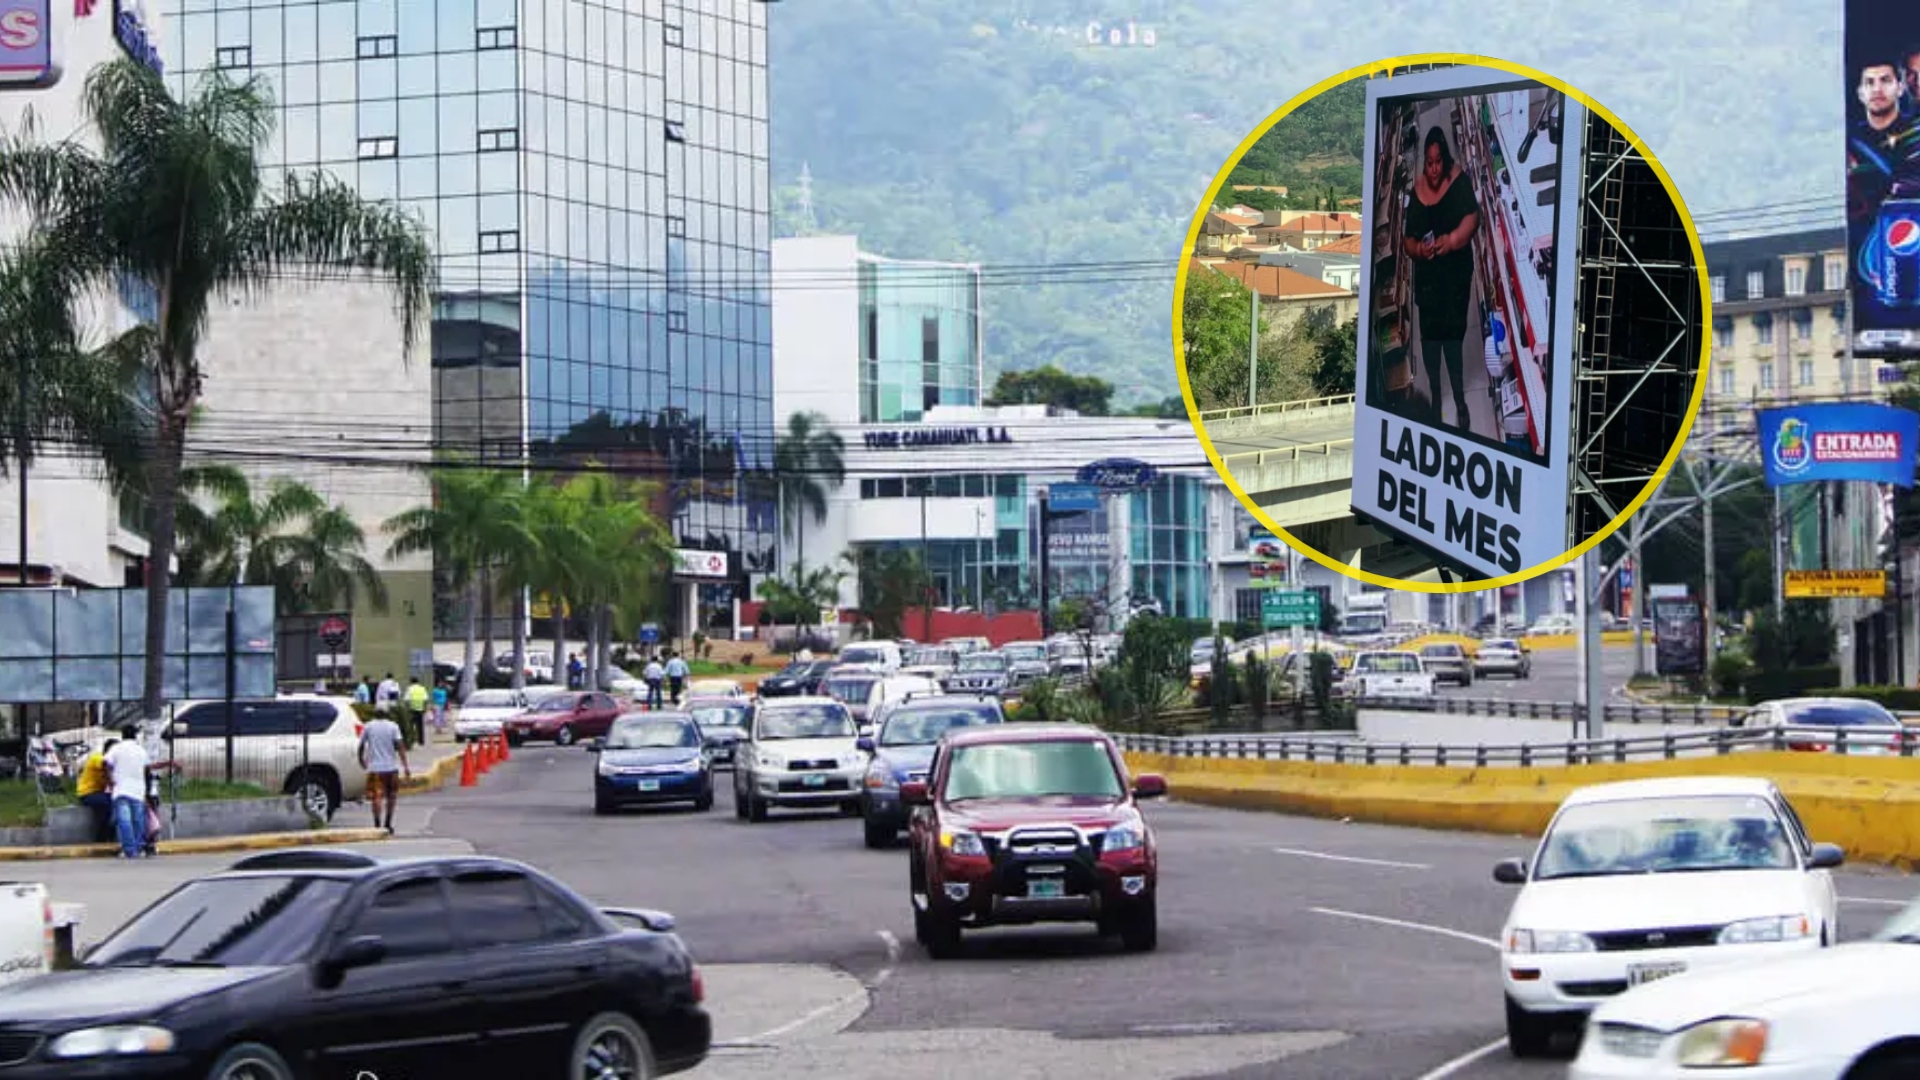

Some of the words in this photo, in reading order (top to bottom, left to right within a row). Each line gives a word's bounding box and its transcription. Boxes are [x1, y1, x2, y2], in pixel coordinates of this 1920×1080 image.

[1086, 19, 1156, 46] Cola
[1380, 418, 1523, 515] LADRON
[1815, 432, 1898, 450] ENTRADA
[1377, 468, 1435, 535] DEL
[1445, 498, 1522, 574] MES
